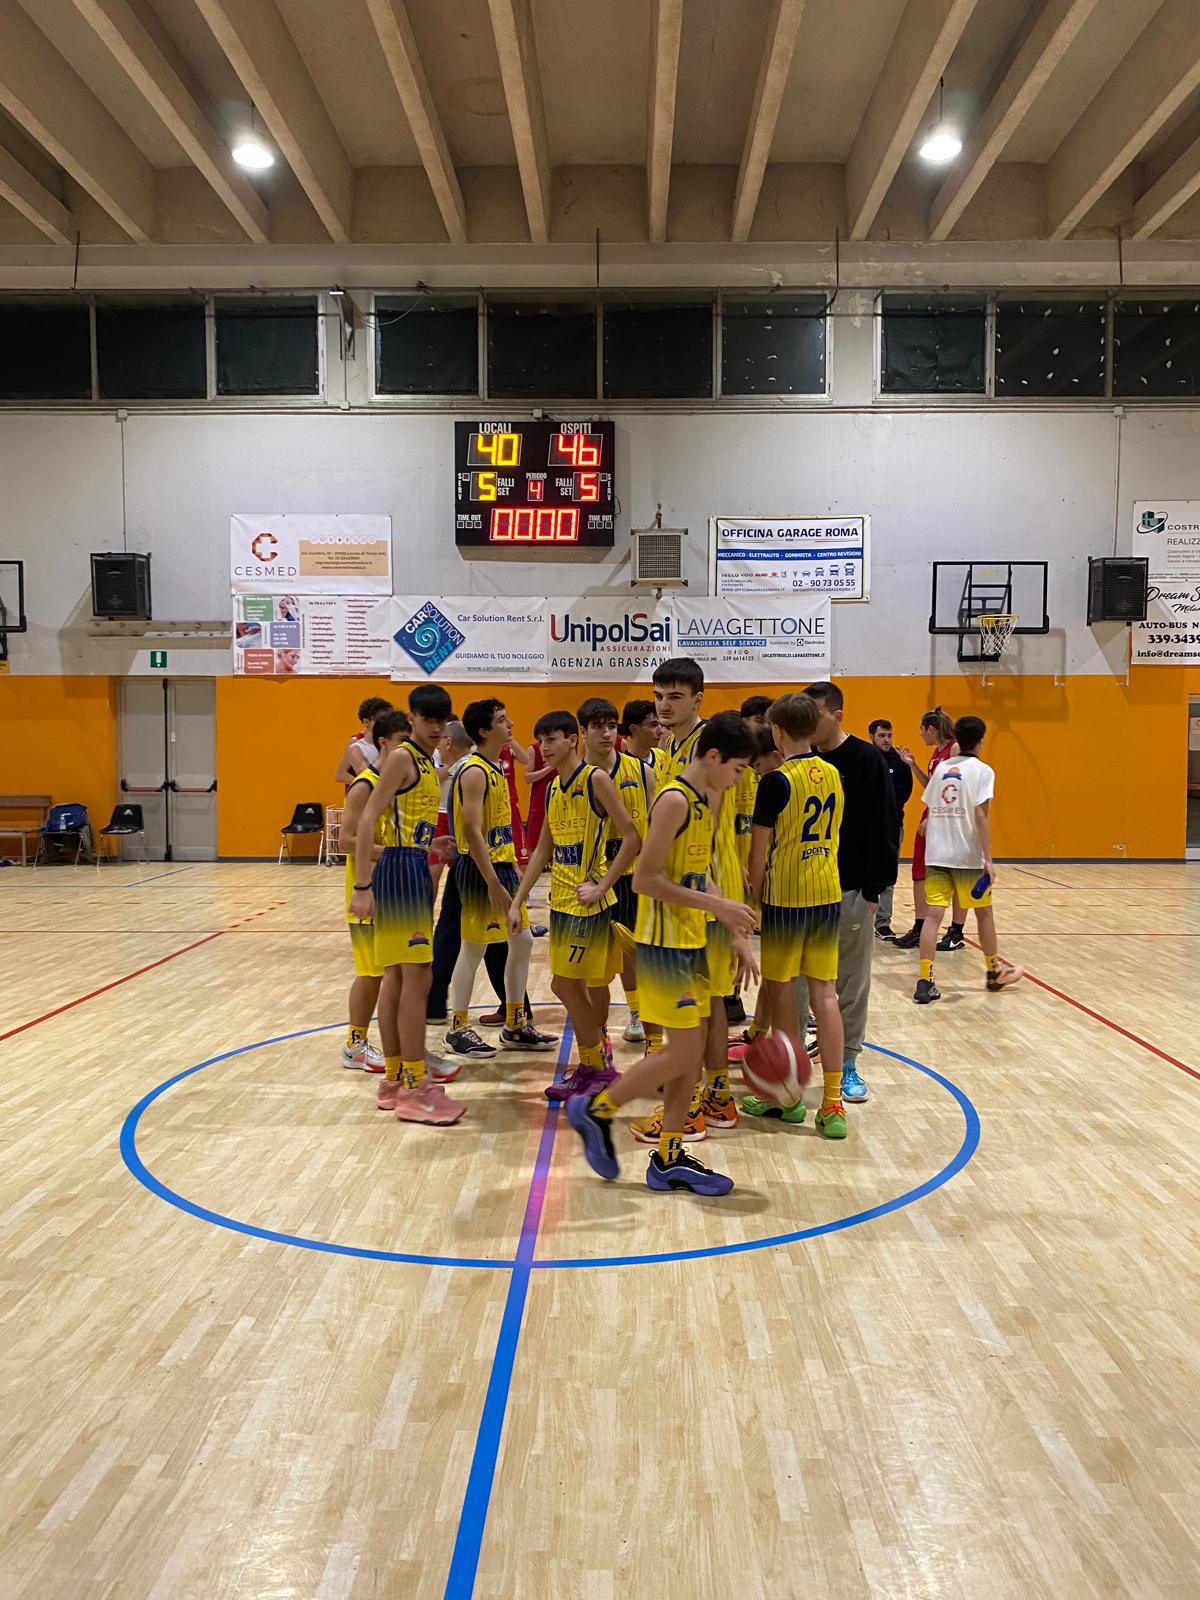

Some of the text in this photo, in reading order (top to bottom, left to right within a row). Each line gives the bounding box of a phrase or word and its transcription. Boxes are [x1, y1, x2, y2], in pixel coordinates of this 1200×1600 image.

[479, 422, 512, 434] LOCALI
[560, 422, 592, 434] OSPITI
[477, 434, 519, 466] 40
[558, 434, 598, 466] 46
[478, 473, 497, 501] 5
[497, 478, 515, 487] FALLI
[529, 481, 542, 500] 4
[555, 478, 573, 487] FALLI
[580, 473, 597, 501] 5
[497, 488, 510, 496] SET
[560, 488, 573, 496] SET
[722, 527, 859, 537] OFFICINA GARAGE ROMA
[234, 566, 297, 576] CESMED
[834, 579, 844, 587] 05
[846, 579, 856, 587] 55
[1146, 586, 1190, 602] Dream
[404, 611, 429, 634] CAR
[423, 603, 464, 646] SOLUTION
[458, 614, 544, 623] Car Solution Rent S.r.l.
[677, 617, 825, 636] LAVAGETTONE
[550, 613, 671, 652] UnipolSai
[424, 638, 455, 672] RENT
[551, 658, 604, 668] AGENZIA
[800, 793, 837, 843] 21
[568, 944, 586, 964] 77
